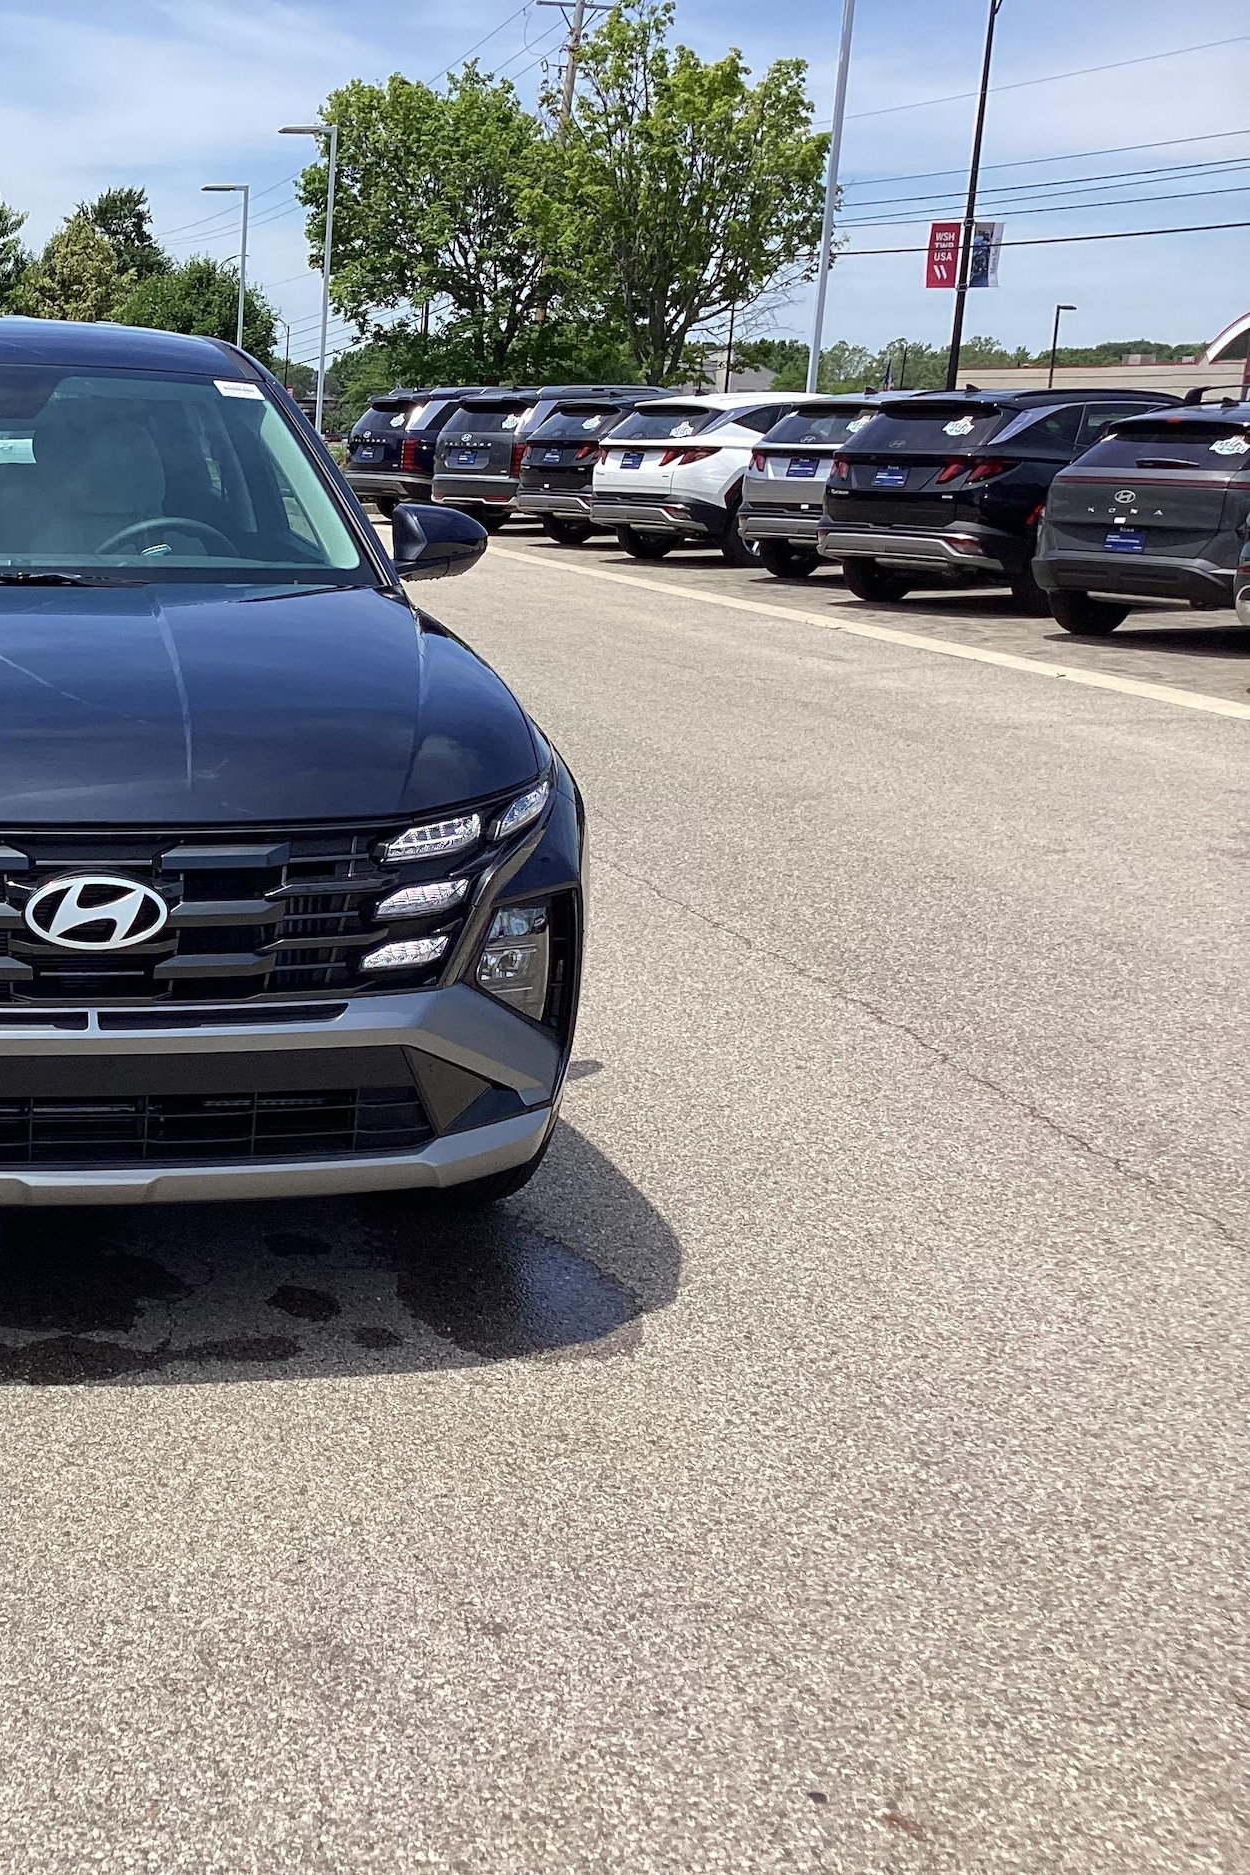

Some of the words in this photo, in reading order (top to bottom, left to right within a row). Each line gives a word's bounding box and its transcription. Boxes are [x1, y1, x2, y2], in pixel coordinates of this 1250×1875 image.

[935, 232, 956, 241] WSH
[933, 252, 953, 261] USA
[1086, 506, 1163, 516] KONA
